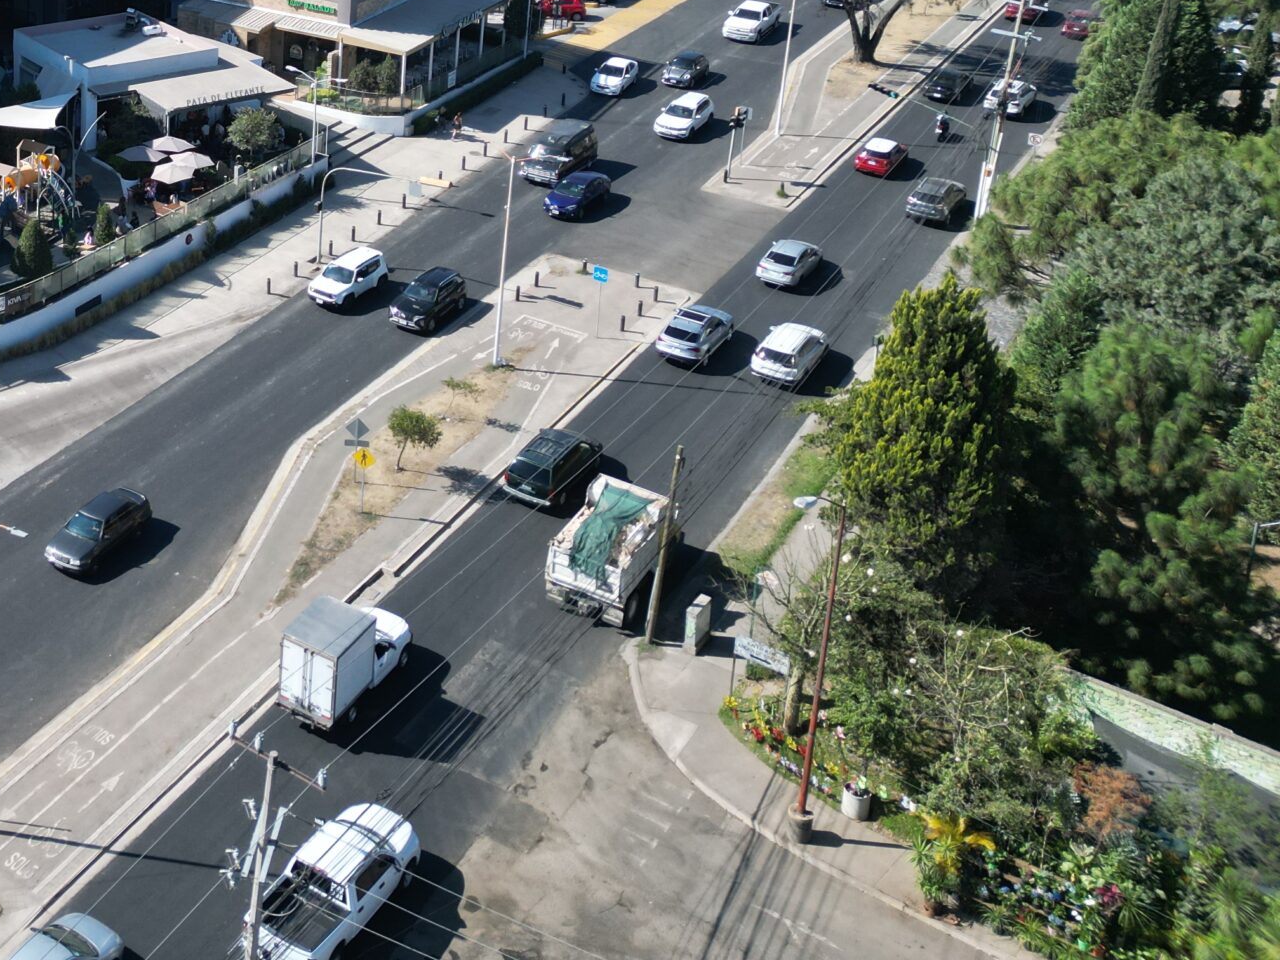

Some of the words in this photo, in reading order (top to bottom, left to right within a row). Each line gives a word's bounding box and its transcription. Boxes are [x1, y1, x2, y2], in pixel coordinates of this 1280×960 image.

[186, 96, 207, 107] PATA
[211, 94, 221, 102] DE
[225, 86, 265, 100] ELEFANTE
[518, 379, 541, 392] SOLO
